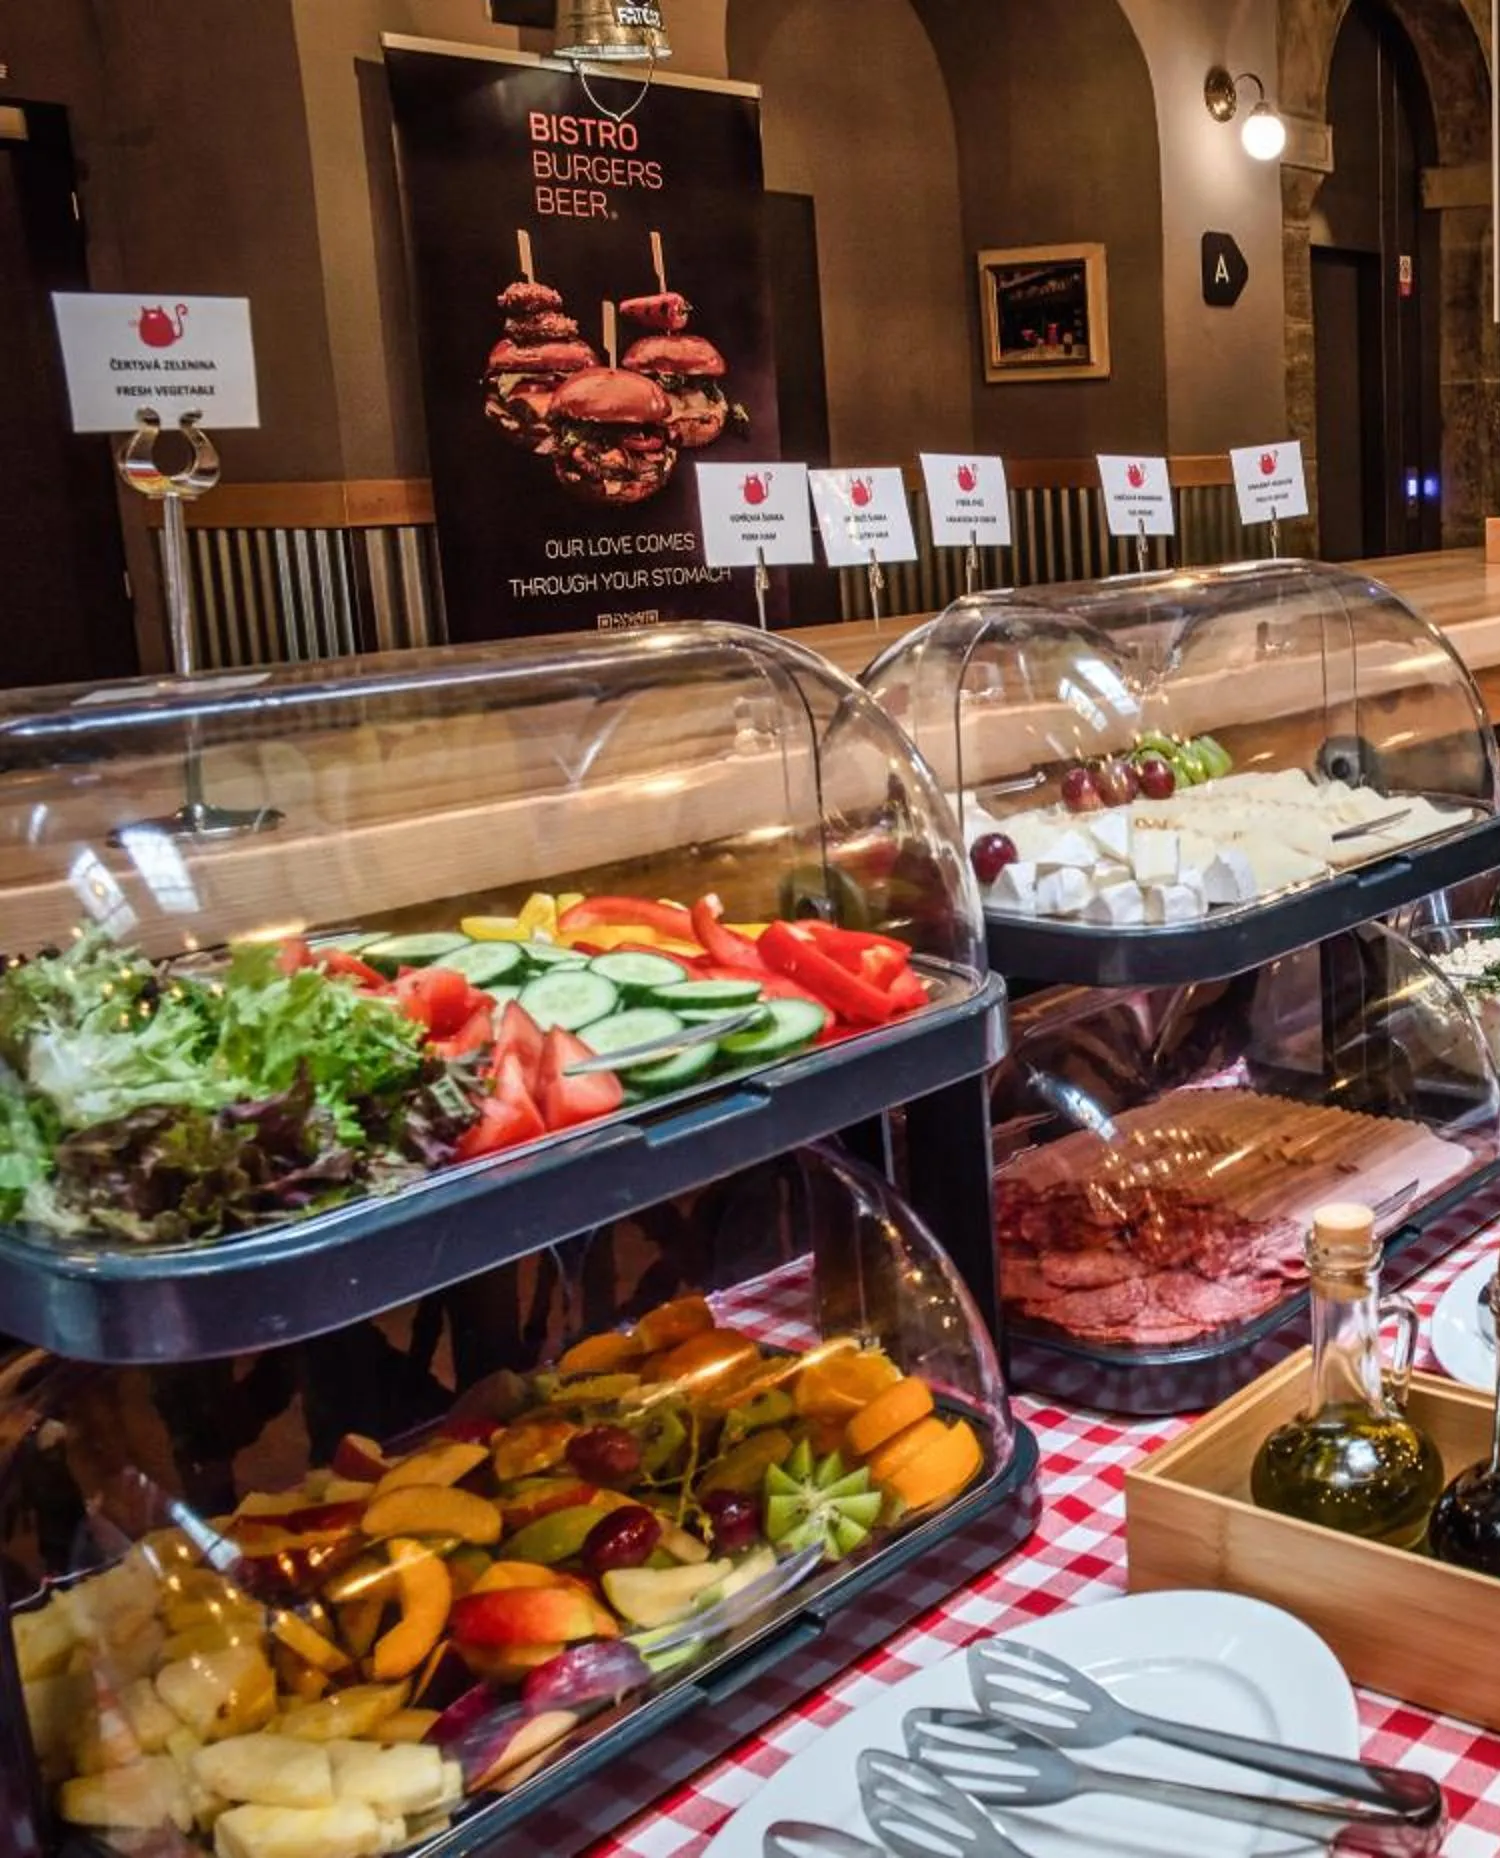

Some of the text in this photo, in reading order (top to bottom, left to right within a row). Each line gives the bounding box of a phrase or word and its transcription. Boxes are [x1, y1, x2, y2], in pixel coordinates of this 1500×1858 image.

[529, 111, 639, 151] BISTRO
[533, 150, 664, 190] BURGERS
[1214, 254, 1230, 284] A
[164, 359, 218, 371] ZELENINA
[116, 385, 216, 397] FRESH VEGETABLE
[545, 532, 695, 560] OUR LOVE COMES
[508, 564, 732, 598] THROUGH YOUR STOMACH
